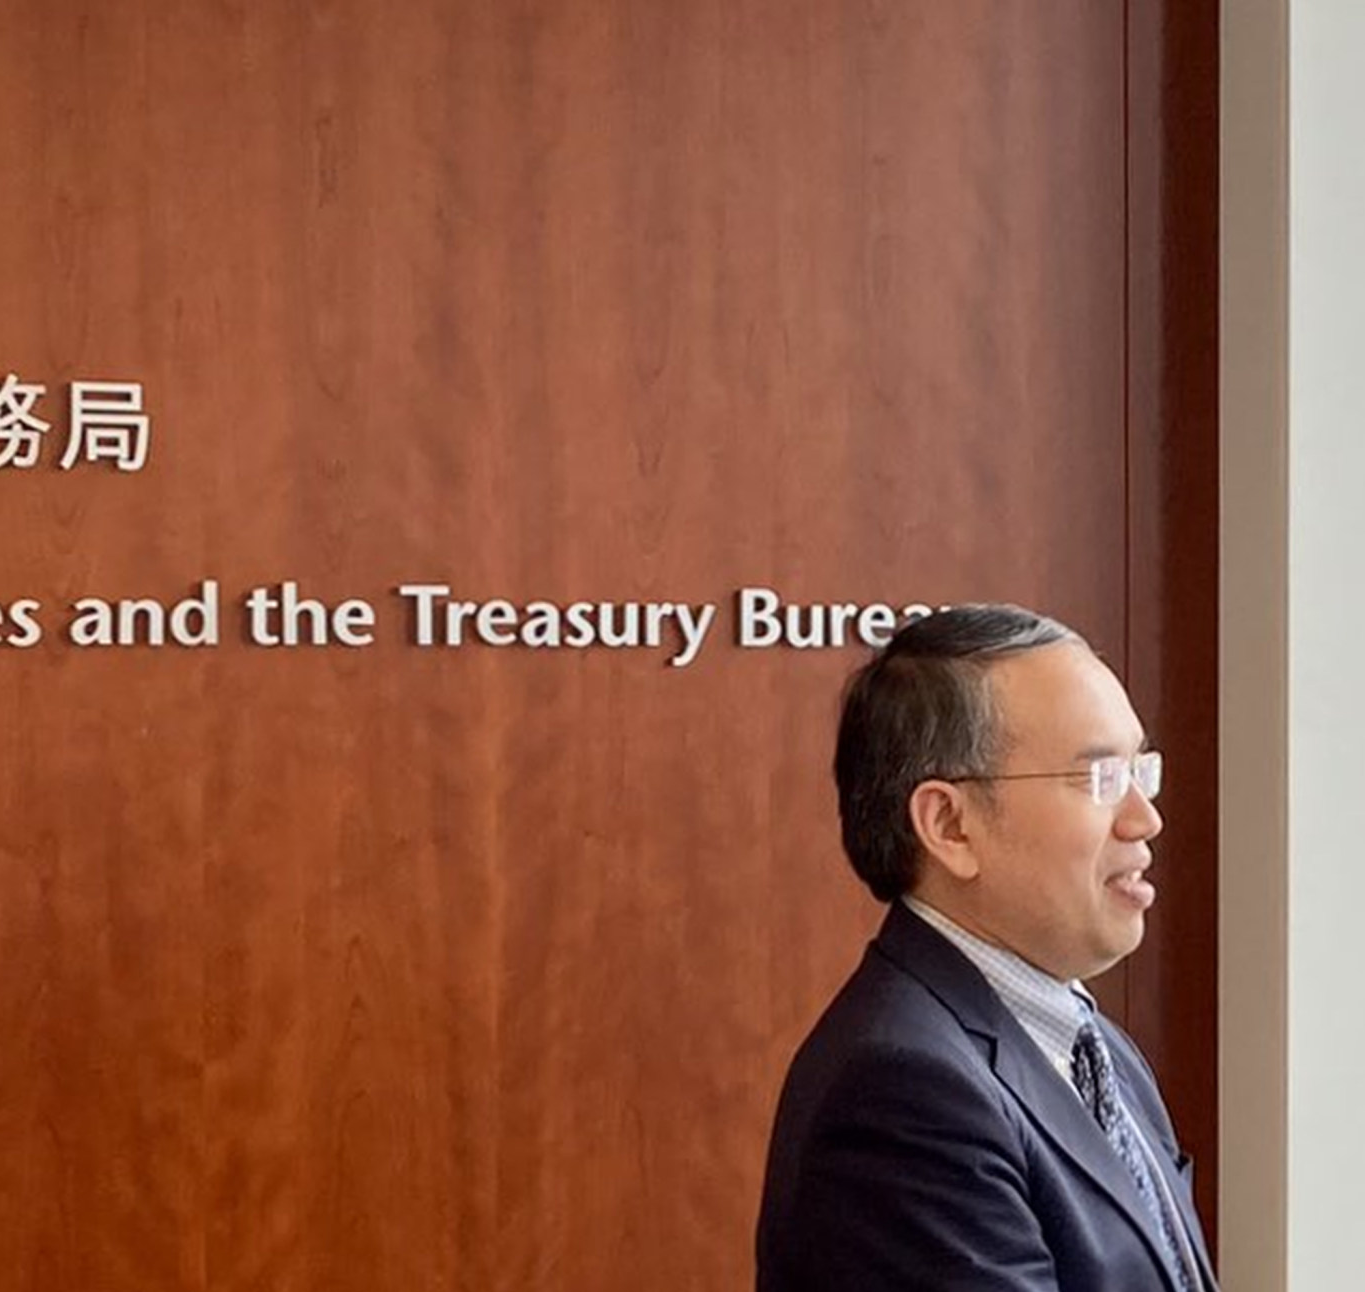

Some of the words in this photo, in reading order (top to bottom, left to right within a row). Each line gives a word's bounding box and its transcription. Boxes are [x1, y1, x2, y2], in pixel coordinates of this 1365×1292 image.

[69, 580, 219, 647] and
[246, 581, 376, 647] the
[399, 584, 717, 668] Treasury
[739, 587, 952, 648] Bure
